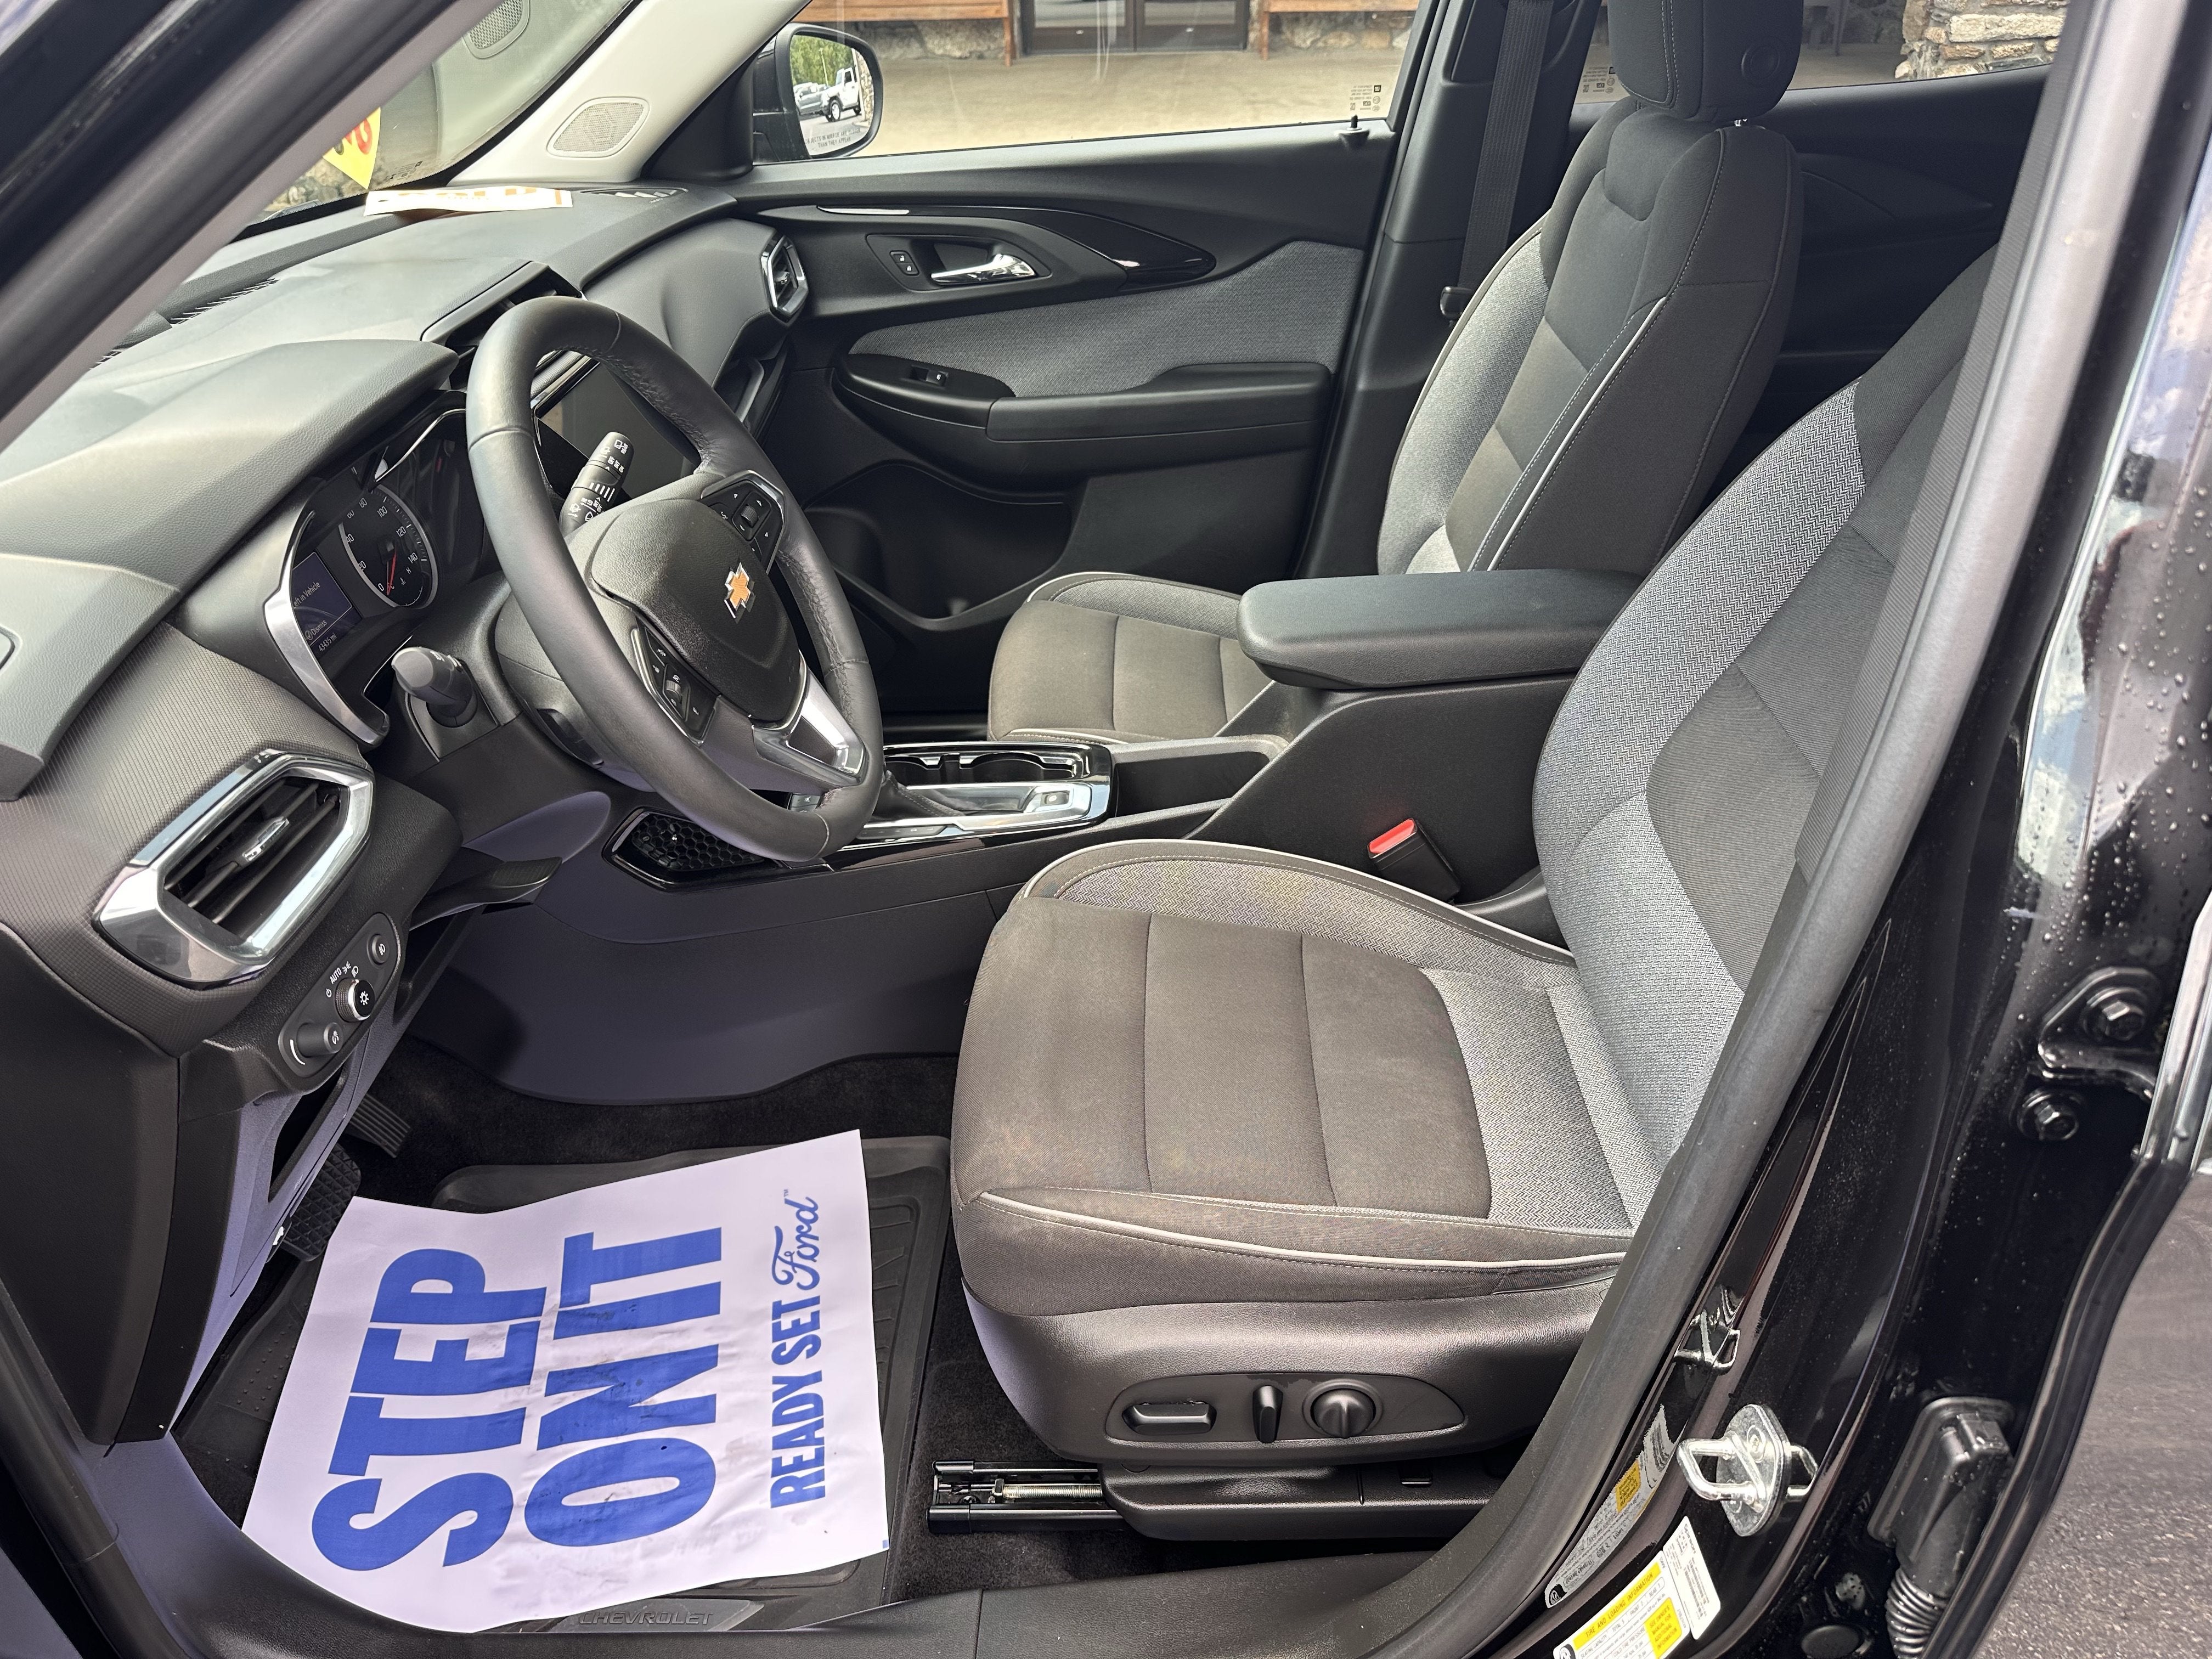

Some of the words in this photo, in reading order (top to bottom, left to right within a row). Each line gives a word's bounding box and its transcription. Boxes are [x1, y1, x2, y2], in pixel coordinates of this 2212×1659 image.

[377, 506, 388, 518] 100
[396, 526, 407, 538] 120
[408, 552, 418, 564] 140
[294, 596, 302, 608] eft
[303, 582, 321, 598] Vehicle
[377, 583, 385, 591] 0
[311, 619, 328, 636] Dismiss
[318, 637, 331, 652] 43435
[330, 967, 342, 984] AUTO
[553, 1227, 722, 1340] IT
[771, 1295, 821, 1365] SET
[312, 1248, 548, 1571] STEP
[525, 1344, 719, 1547] ON
[770, 1370, 826, 1508] READY
[1585, 1626, 1595, 1638] TIRE
[1597, 1617, 1606, 1628] AND
[1607, 1599, 1626, 1620] LOADING
[1627, 1571, 1653, 1601] INFORMATION
[579, 1611, 713, 1625] CHEVROLET
